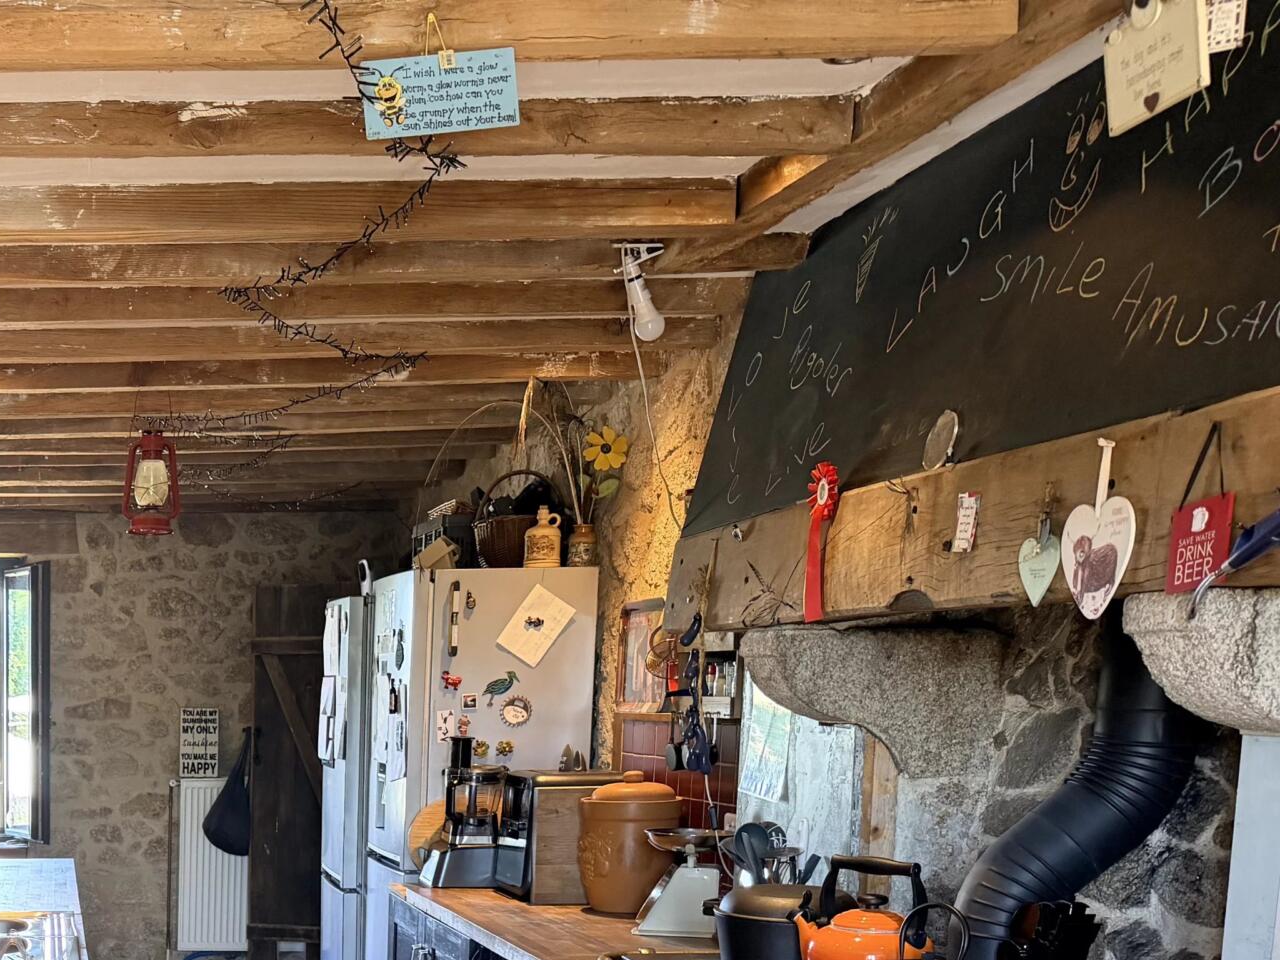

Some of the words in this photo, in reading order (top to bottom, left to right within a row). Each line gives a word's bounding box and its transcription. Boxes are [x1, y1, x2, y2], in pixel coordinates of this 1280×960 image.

[402, 67, 411, 79] I
[414, 66, 435, 78] wish
[467, 65, 473, 73] a
[476, 62, 498, 75] glow
[435, 81, 453, 92] glow
[487, 75, 512, 85] never
[445, 91, 463, 101] how
[465, 91, 482, 99] can
[417, 107, 455, 121] grumpy
[456, 102, 482, 115] when
[483, 100, 502, 112] the
[401, 122, 421, 131] sun
[422, 119, 453, 130] shines
[456, 116, 472, 126] out
[474, 115, 497, 127] your
[1178, 535, 1194, 547] SAVE
[1195, 530, 1216, 542] WATER
[1176, 540, 1215, 564] DRINK
[182, 726, 194, 734] MY
[196, 726, 217, 734] ONLY
[182, 762, 217, 775] HAPPY
